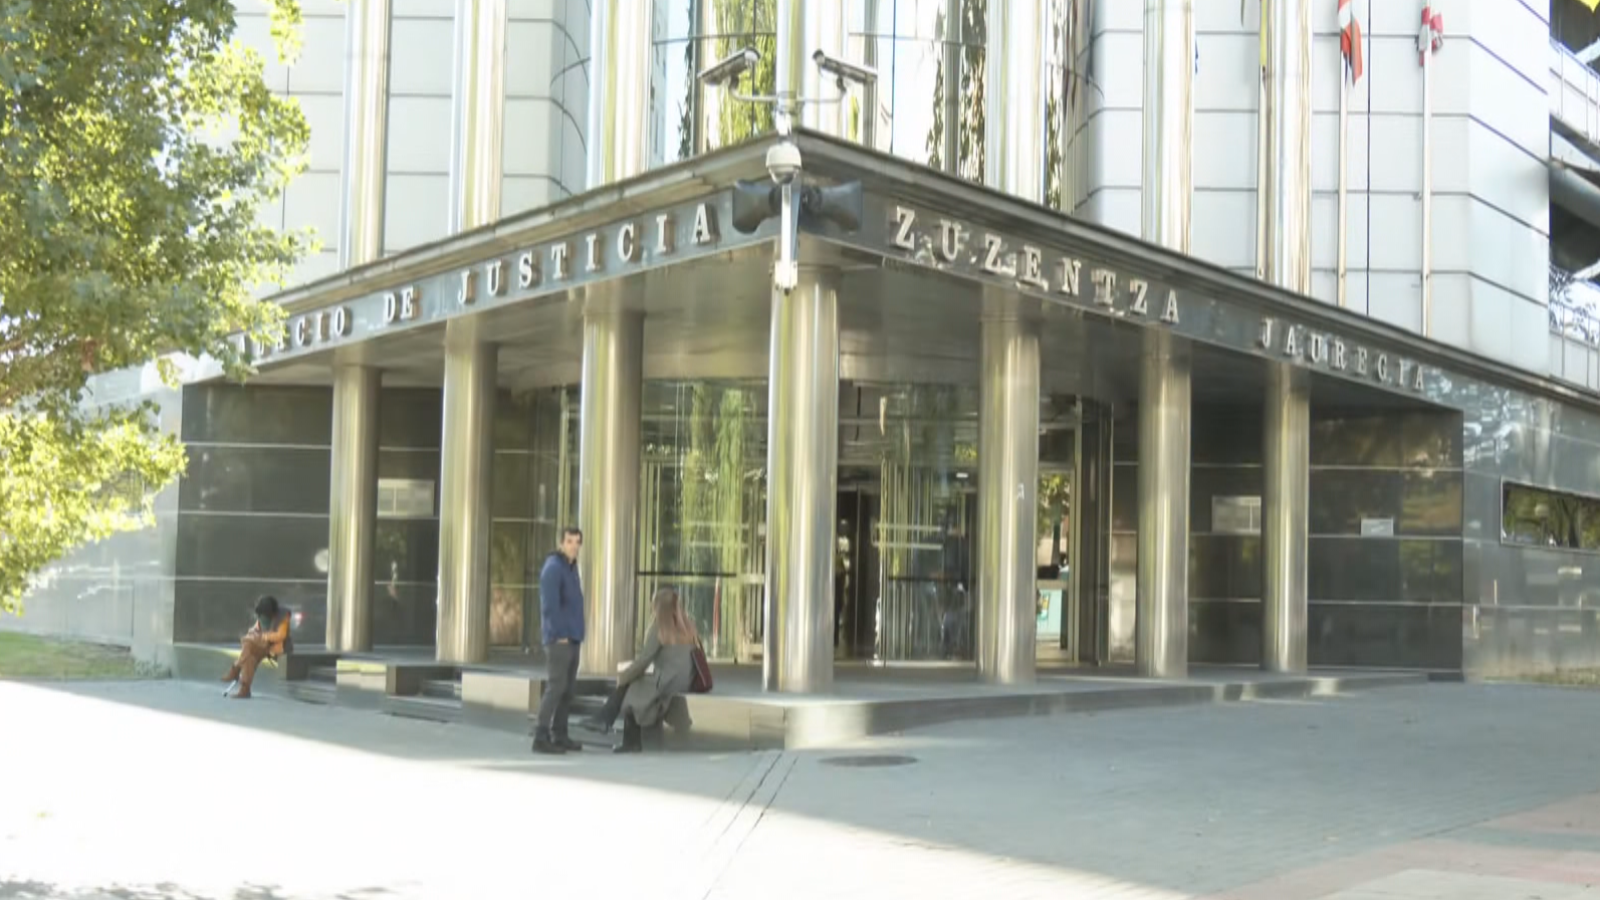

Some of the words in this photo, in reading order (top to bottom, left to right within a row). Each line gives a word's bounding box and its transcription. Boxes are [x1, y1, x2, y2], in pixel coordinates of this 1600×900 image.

[383, 286, 415, 324] DE
[457, 203, 712, 304] JUSTICIA
[894, 205, 1180, 325] ZUZENTZA
[1261, 316, 1425, 391] JAUREGIA
